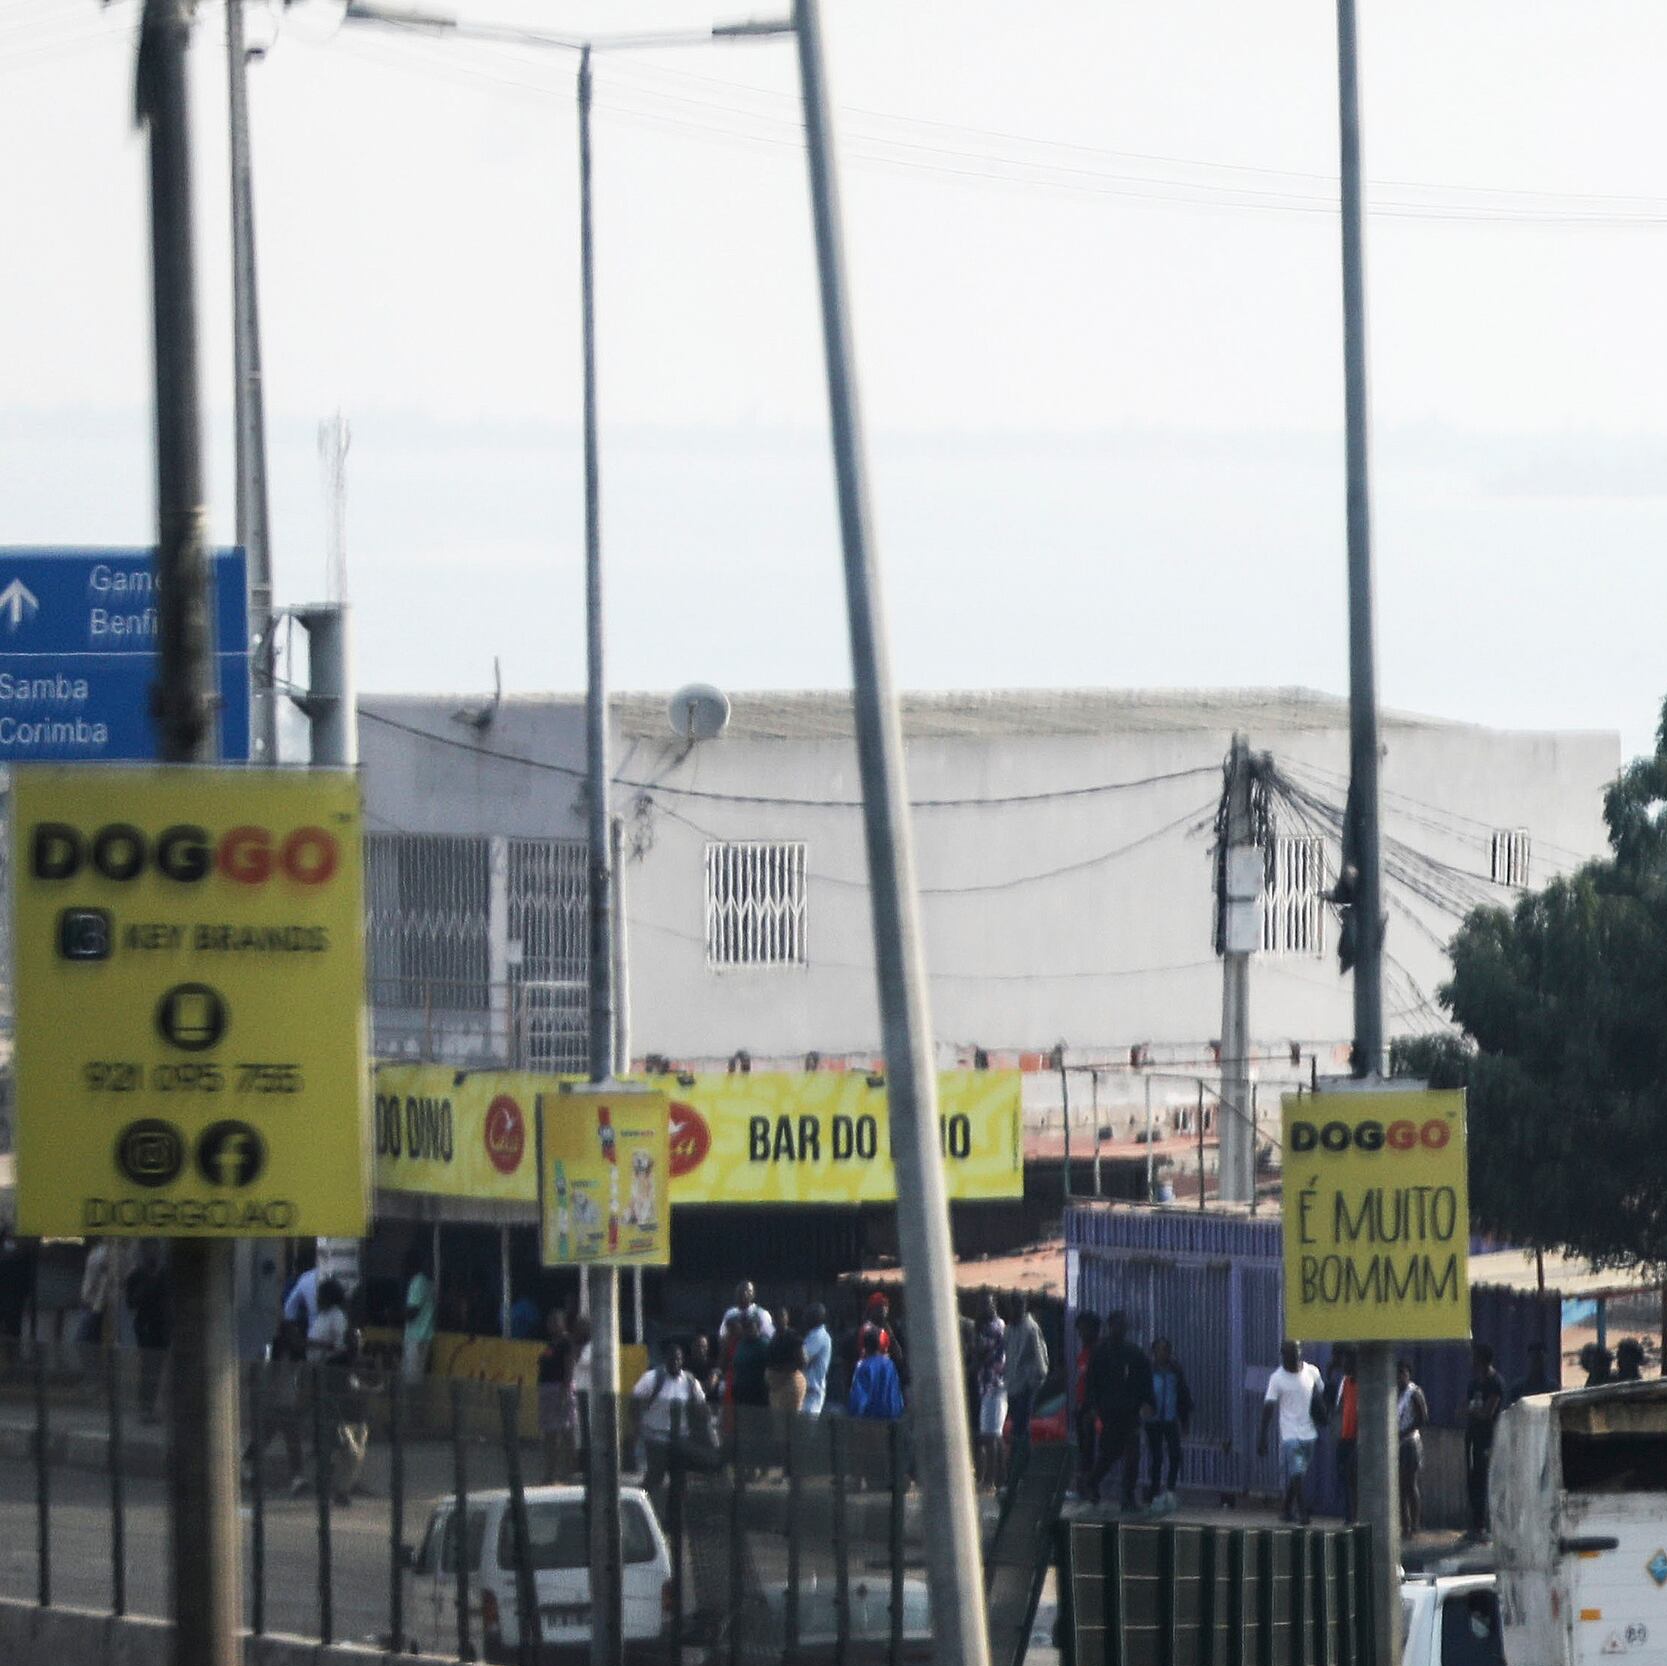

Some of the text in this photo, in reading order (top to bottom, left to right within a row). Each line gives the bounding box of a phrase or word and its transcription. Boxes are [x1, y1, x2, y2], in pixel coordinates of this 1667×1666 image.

[0, 673, 89, 700] Samba
[0, 717, 108, 744] Corimba
[31, 821, 340, 886] DOGGO
[749, 1113, 878, 1163] BAR DO
[1290, 1119, 1451, 1151] DOGGO
[1299, 1174, 1457, 1244] É MUITO
[1301, 1253, 1459, 1304] BOMMM
